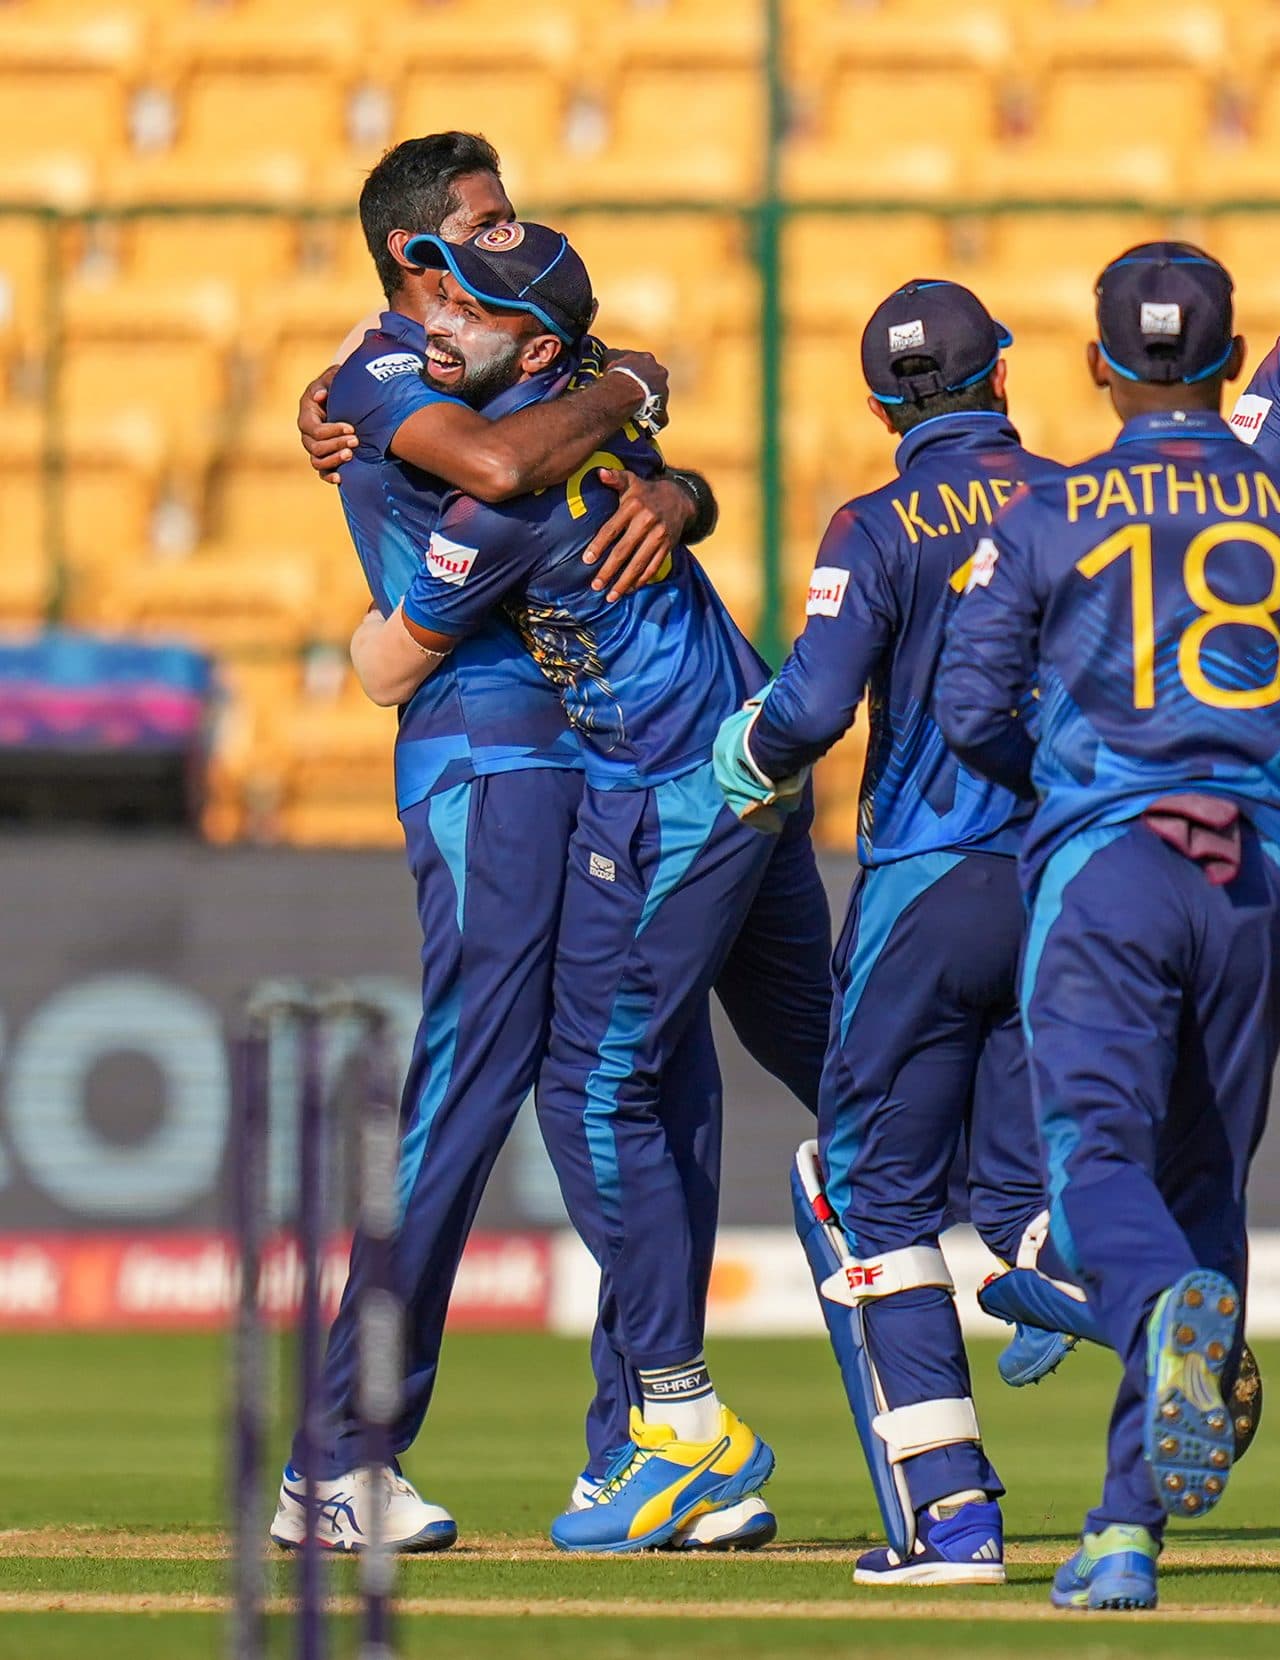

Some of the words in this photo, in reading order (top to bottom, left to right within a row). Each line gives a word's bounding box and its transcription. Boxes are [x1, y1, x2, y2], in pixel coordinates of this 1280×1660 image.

[891, 479, 1025, 544] K.ME
[845, 1264, 884, 1290] SF
[652, 1374, 701, 1394] SHREY
